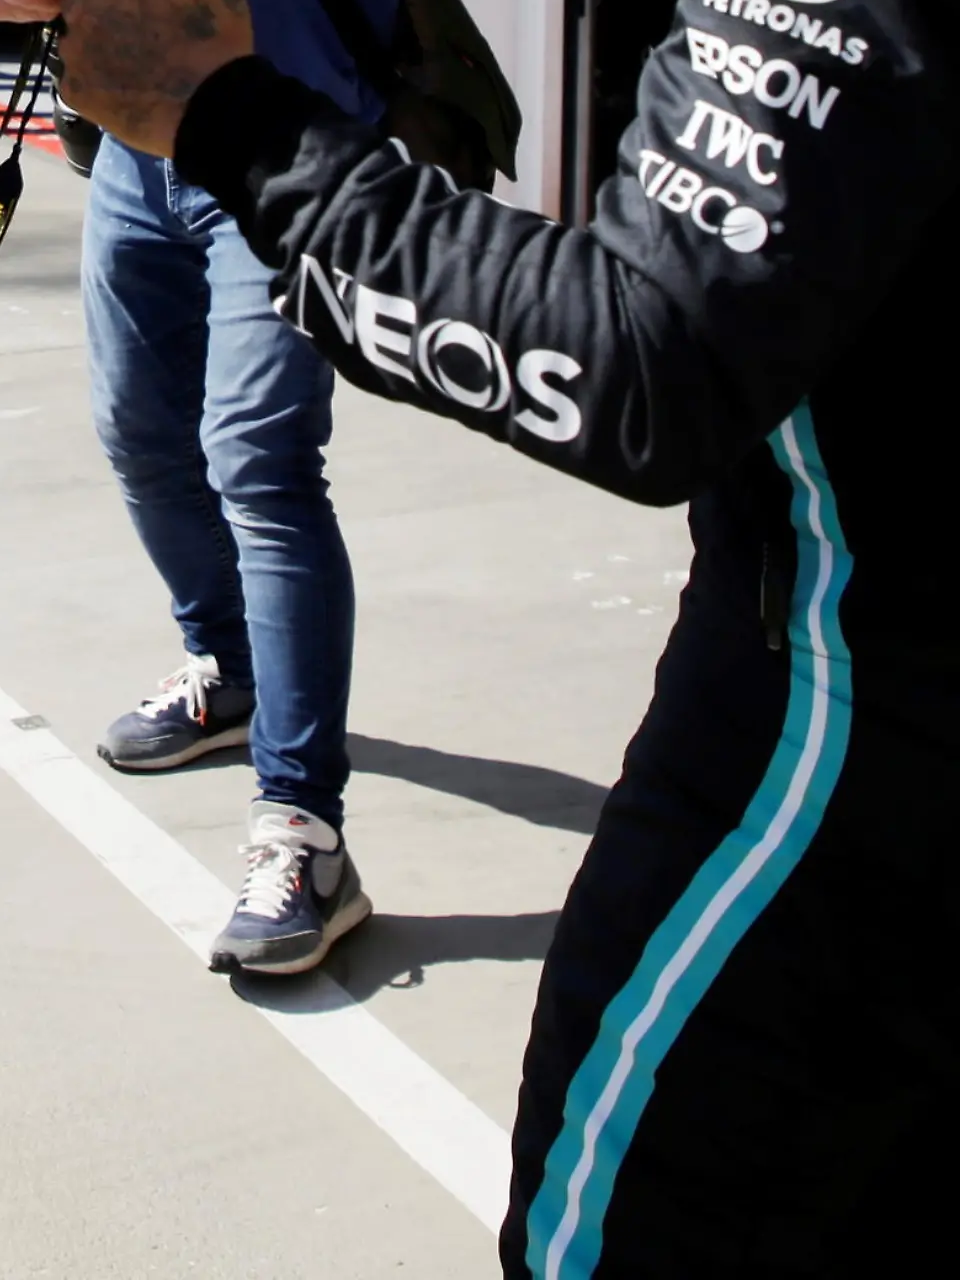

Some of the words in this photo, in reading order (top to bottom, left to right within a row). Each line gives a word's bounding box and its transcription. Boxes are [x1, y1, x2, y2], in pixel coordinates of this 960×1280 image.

[686, 27, 840, 130] EPSON
[676, 99, 784, 186] IWC
[638, 149, 768, 253] TIBCO
